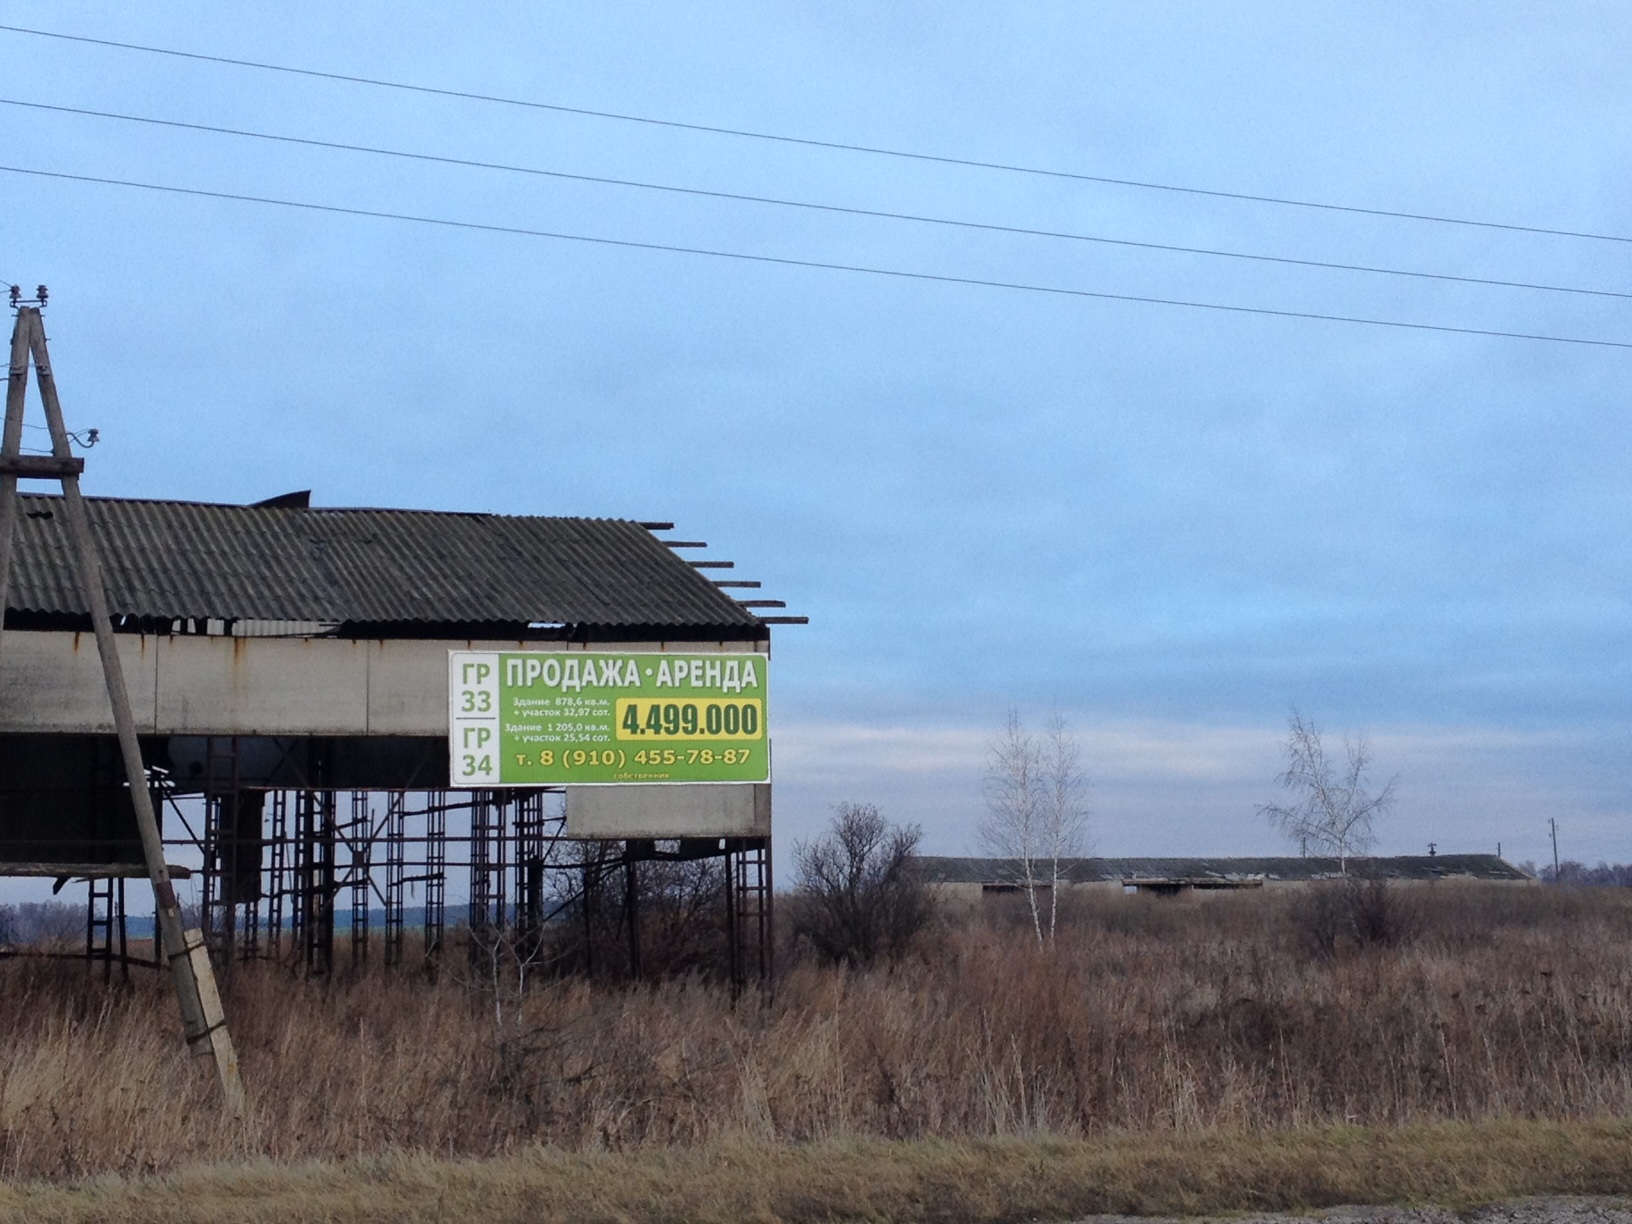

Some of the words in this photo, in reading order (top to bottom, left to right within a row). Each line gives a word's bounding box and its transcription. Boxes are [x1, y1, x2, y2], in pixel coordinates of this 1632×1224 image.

[463, 663, 491, 685] ГР
[506, 658, 641, 692] ПРОДАЖА
[656, 659, 758, 693] АРЕНДА
[461, 690, 492, 712] 33
[513, 697, 550, 707] Здание
[555, 697, 582, 707] 878,6
[584, 698, 611, 706] кв.м.
[522, 709, 561, 718] участок
[563, 708, 590, 717] 32,97
[592, 709, 611, 717] сот.
[622, 703, 757, 735] 4.499.000
[463, 727, 491, 749] ГР
[505, 723, 542, 733] Здание
[556, 723, 583, 733] 205,0
[523, 734, 561, 743] участок
[563, 733, 590, 743] 25,54
[592, 734, 611, 742] сот.
[462, 754, 493, 776] 34
[516, 753, 532, 766] т.
[540, 750, 554, 766] 8
[562, 749, 626, 769] (910)
[634, 749, 751, 765] 455-78-87
[613, 772, 670, 780] собственник
